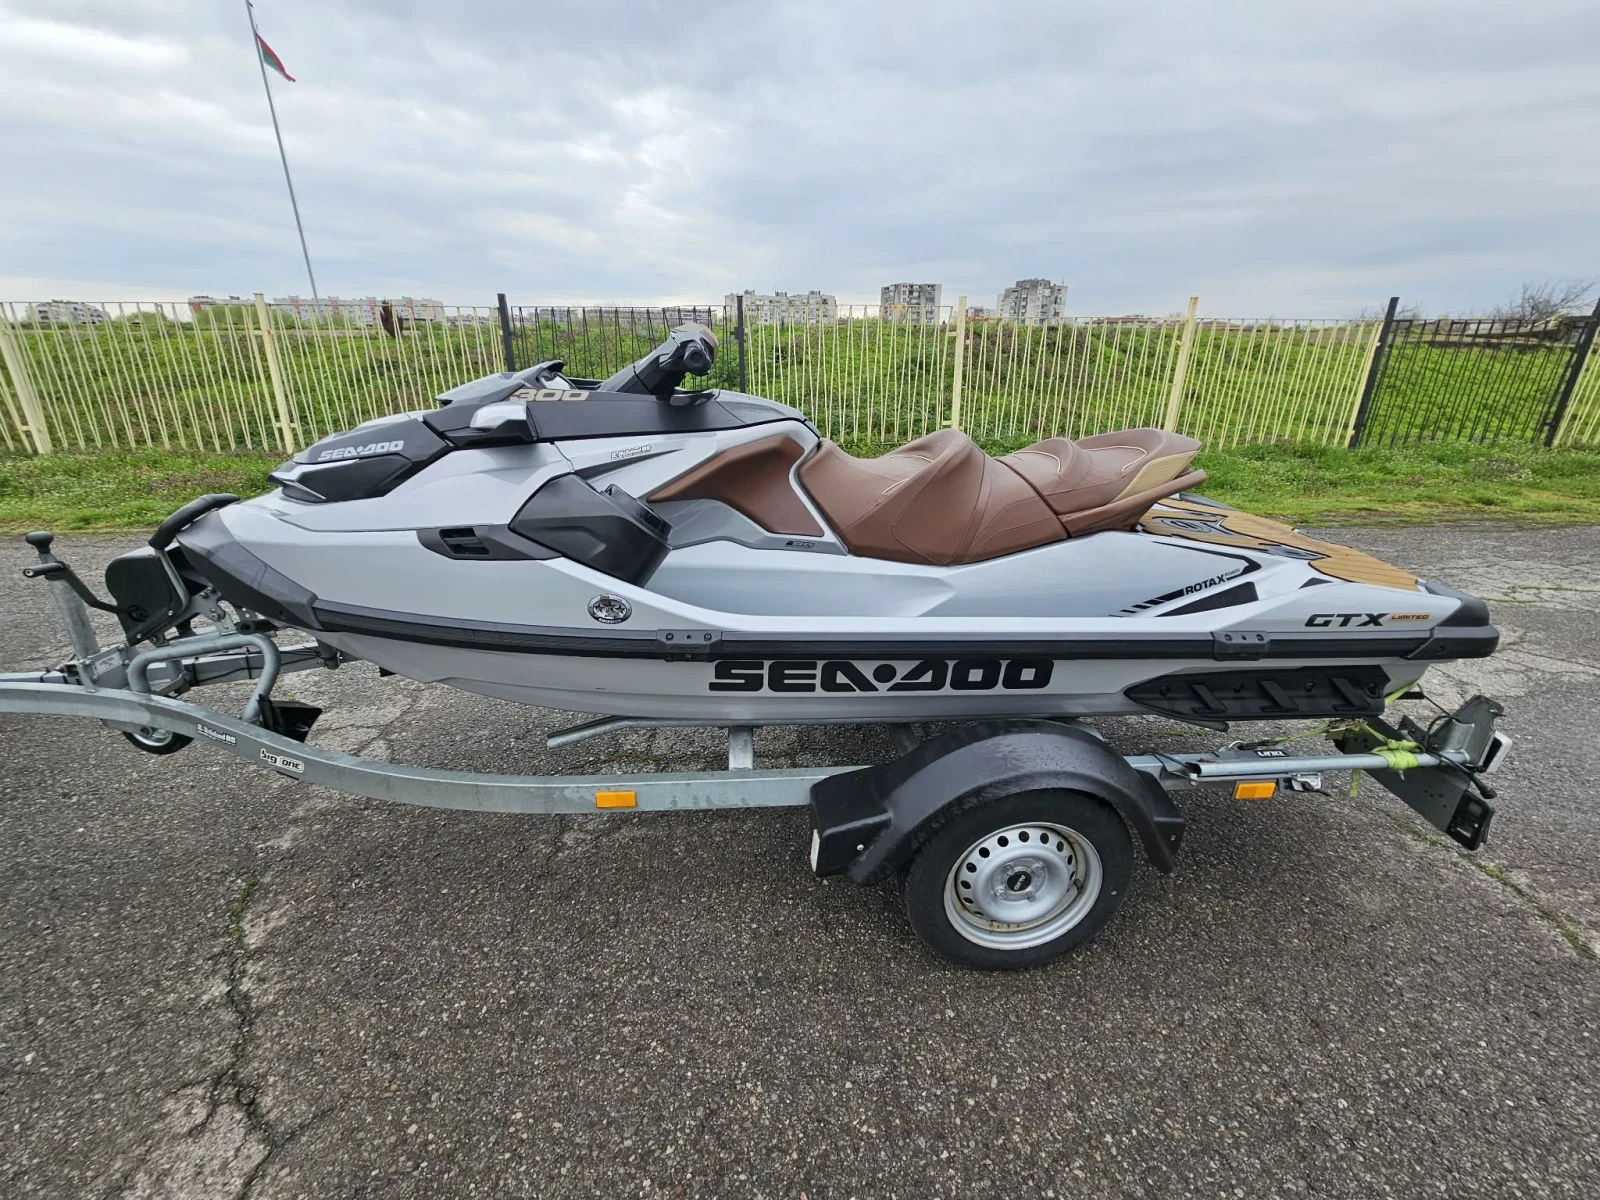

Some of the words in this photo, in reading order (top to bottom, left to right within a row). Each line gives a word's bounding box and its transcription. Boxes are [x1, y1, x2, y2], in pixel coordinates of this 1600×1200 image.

[510, 388, 589, 401] 300
[1185, 574, 1226, 596] ROTAX
[1304, 613, 1390, 627] GTX
